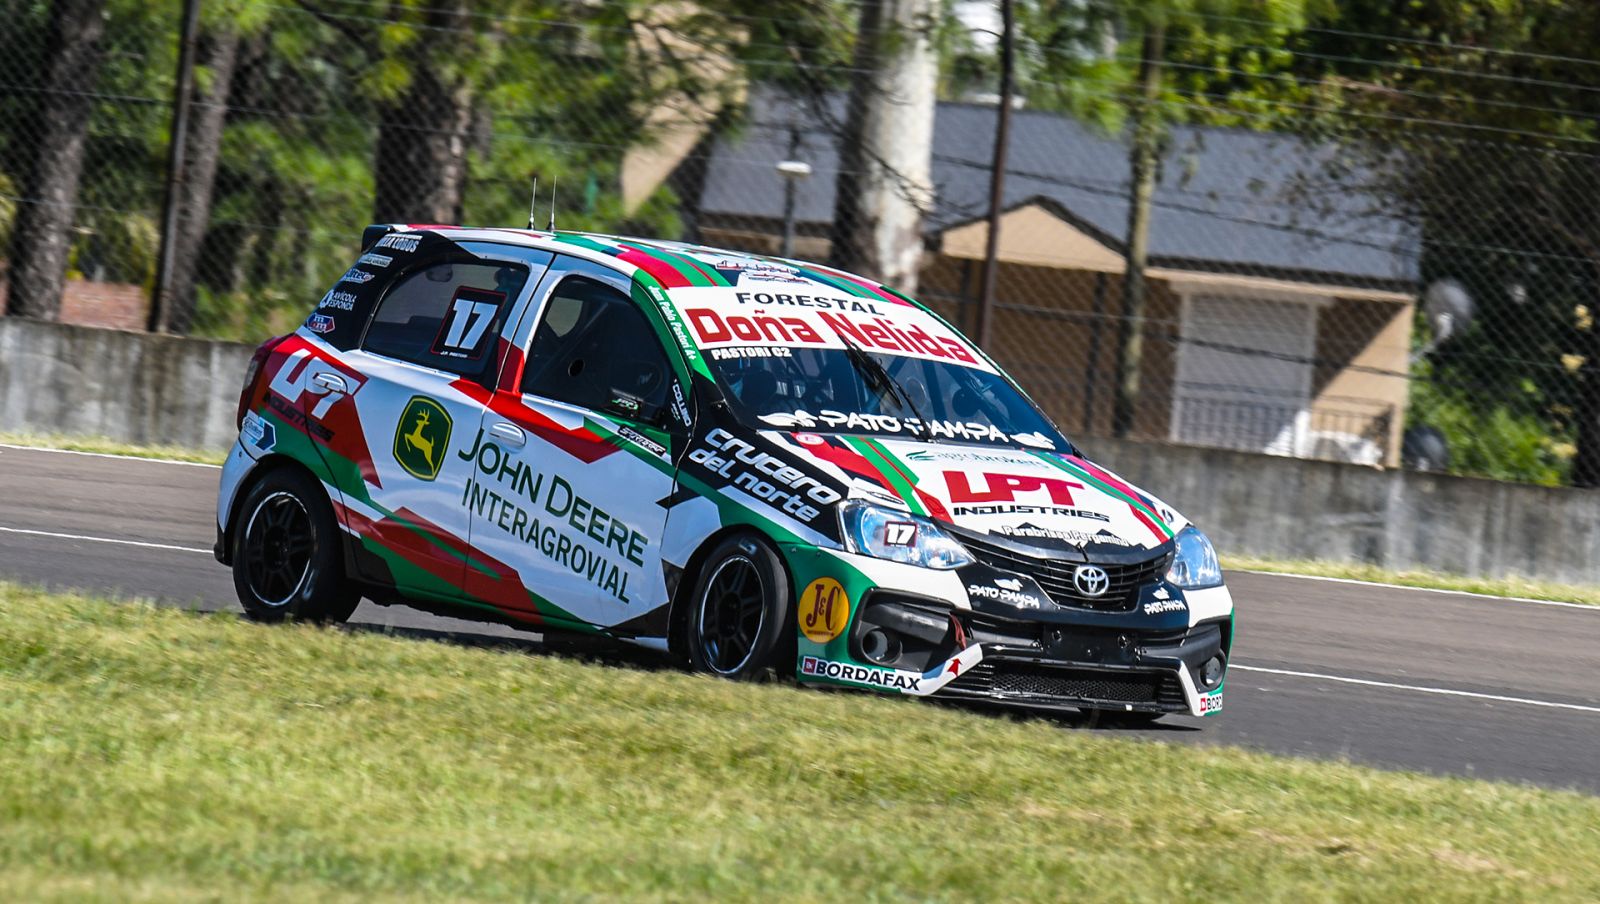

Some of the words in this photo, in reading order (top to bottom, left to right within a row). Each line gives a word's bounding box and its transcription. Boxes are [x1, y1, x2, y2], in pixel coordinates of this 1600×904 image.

[735, 292, 886, 316] FORESTAL
[444, 298, 499, 350] 17
[659, 301, 677, 321] Pablo
[670, 321, 693, 349] Pastori
[684, 308, 827, 344] Doña
[816, 310, 980, 366] Nelida
[711, 346, 773, 361] PASTORI
[818, 409, 903, 433] PATO
[903, 416, 1010, 443] PAMPA
[457, 427, 544, 504] JOHN
[544, 474, 649, 568] DEERE
[688, 448, 737, 479] del
[734, 471, 820, 522] norte
[942, 470, 1085, 507] LPT
[953, 505, 1111, 523] INDUSTRIES
[461, 478, 630, 604] INTERAGROVIAL
[886, 523, 916, 545] 17
[967, 584, 999, 599] PATO
[999, 589, 1040, 610] PAMPA
[1143, 601, 1164, 615] PATO
[1162, 599, 1187, 611] PAMPA
[816, 661, 923, 692] BORDAFAX
